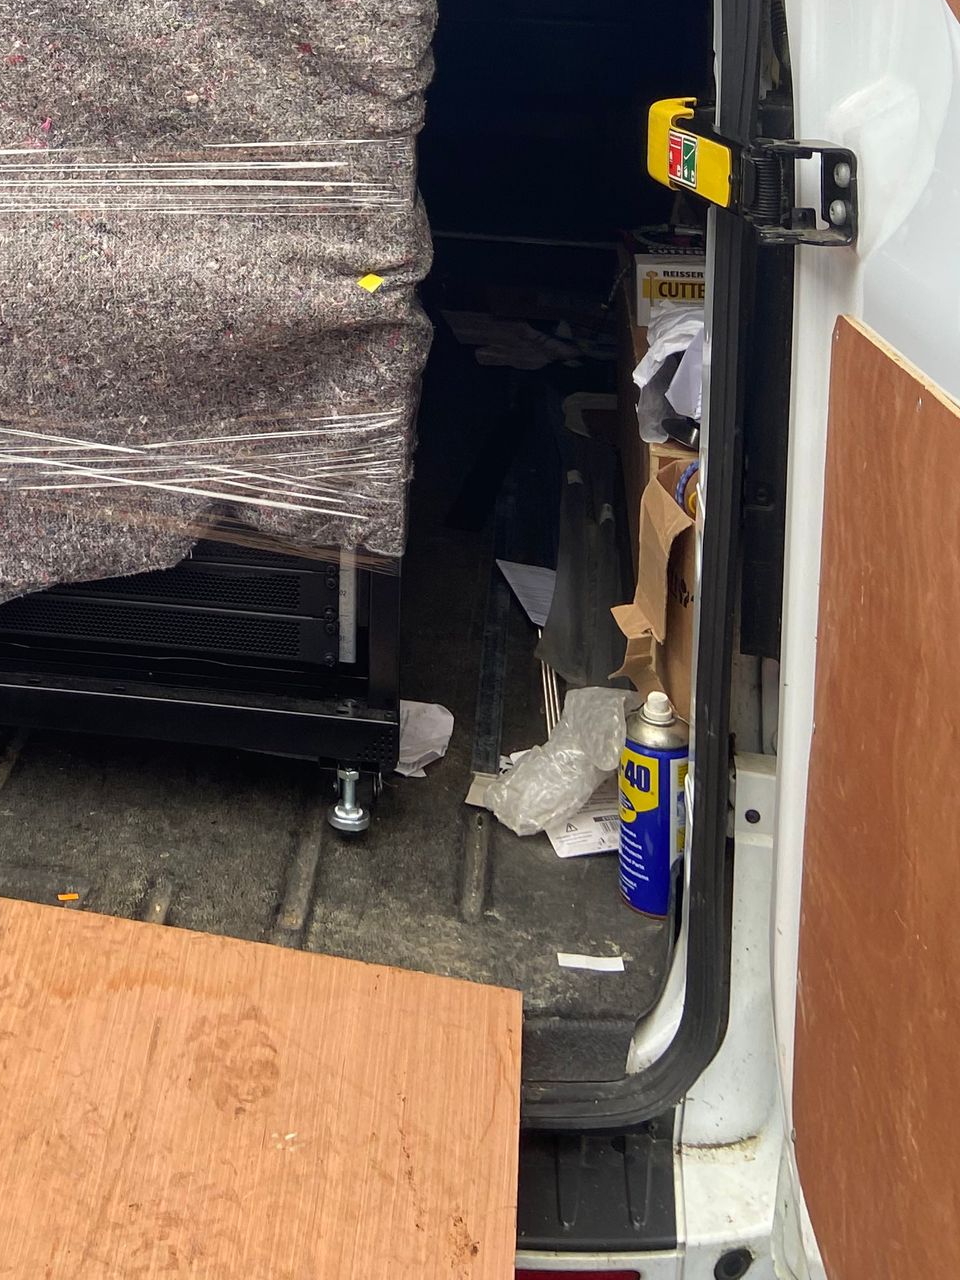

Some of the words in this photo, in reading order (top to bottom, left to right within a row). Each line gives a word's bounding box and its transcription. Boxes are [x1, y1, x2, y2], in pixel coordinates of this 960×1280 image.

[663, 270, 704, 278] REISSER
[658, 282, 705, 299] CUTTE
[620, 760, 650, 792] -40
